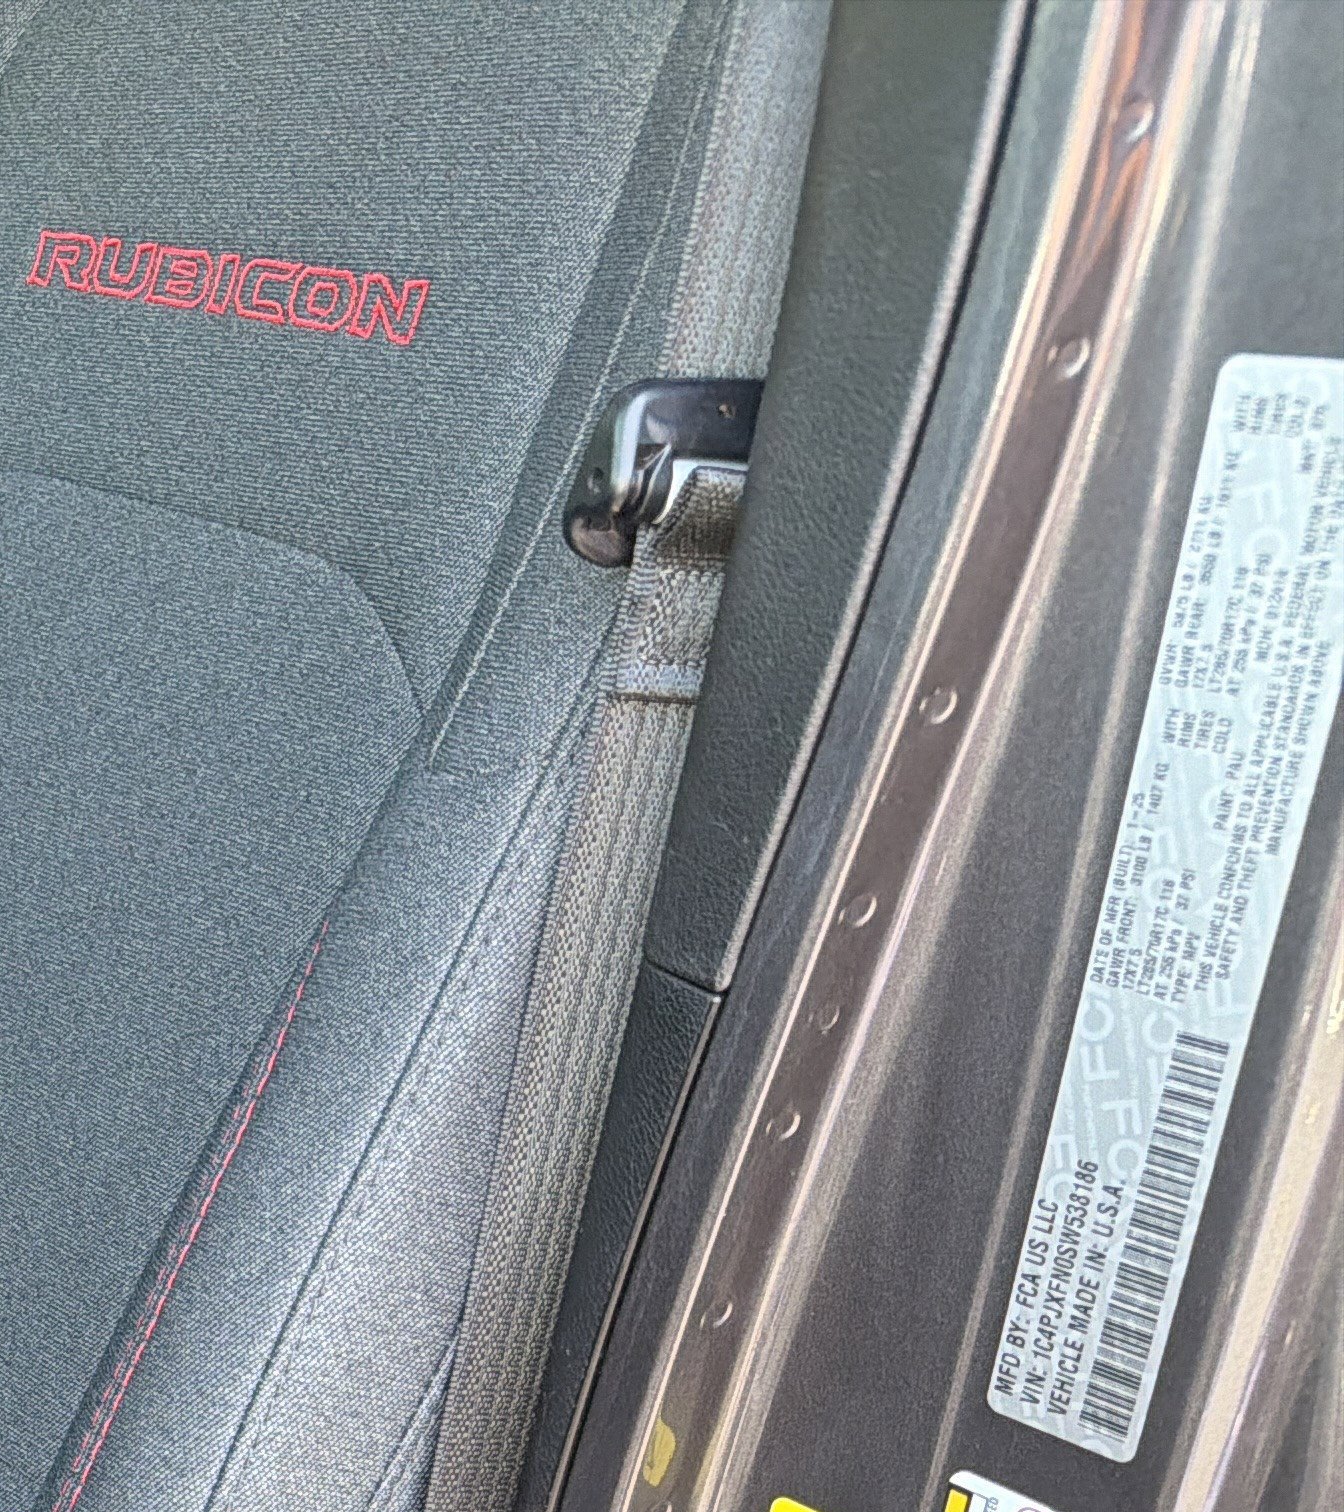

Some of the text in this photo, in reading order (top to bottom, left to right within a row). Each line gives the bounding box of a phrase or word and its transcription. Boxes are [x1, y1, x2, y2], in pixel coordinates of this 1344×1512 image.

[26, 229, 430, 346] RUBICON
[1216, 821, 1248, 902] CONFORMS
[1103, 893, 1122, 925] MFR
[1201, 900, 1229, 960] VEHICLE
[1097, 926, 1114, 947] OF
[1214, 926, 1240, 981] SAFETY
[1227, 893, 1248, 926] AND
[1089, 947, 1109, 984] DATE
[1104, 945, 1127, 989] GAWR
[1192, 960, 1214, 993] THIS
[993, 1196, 1059, 1396] MFD BY: FCA US LLC
[1046, 1173, 1126, 1418] VEHICLE MADE IN: U.S.A.
[1019, 1364, 1047, 1406] VIN:
